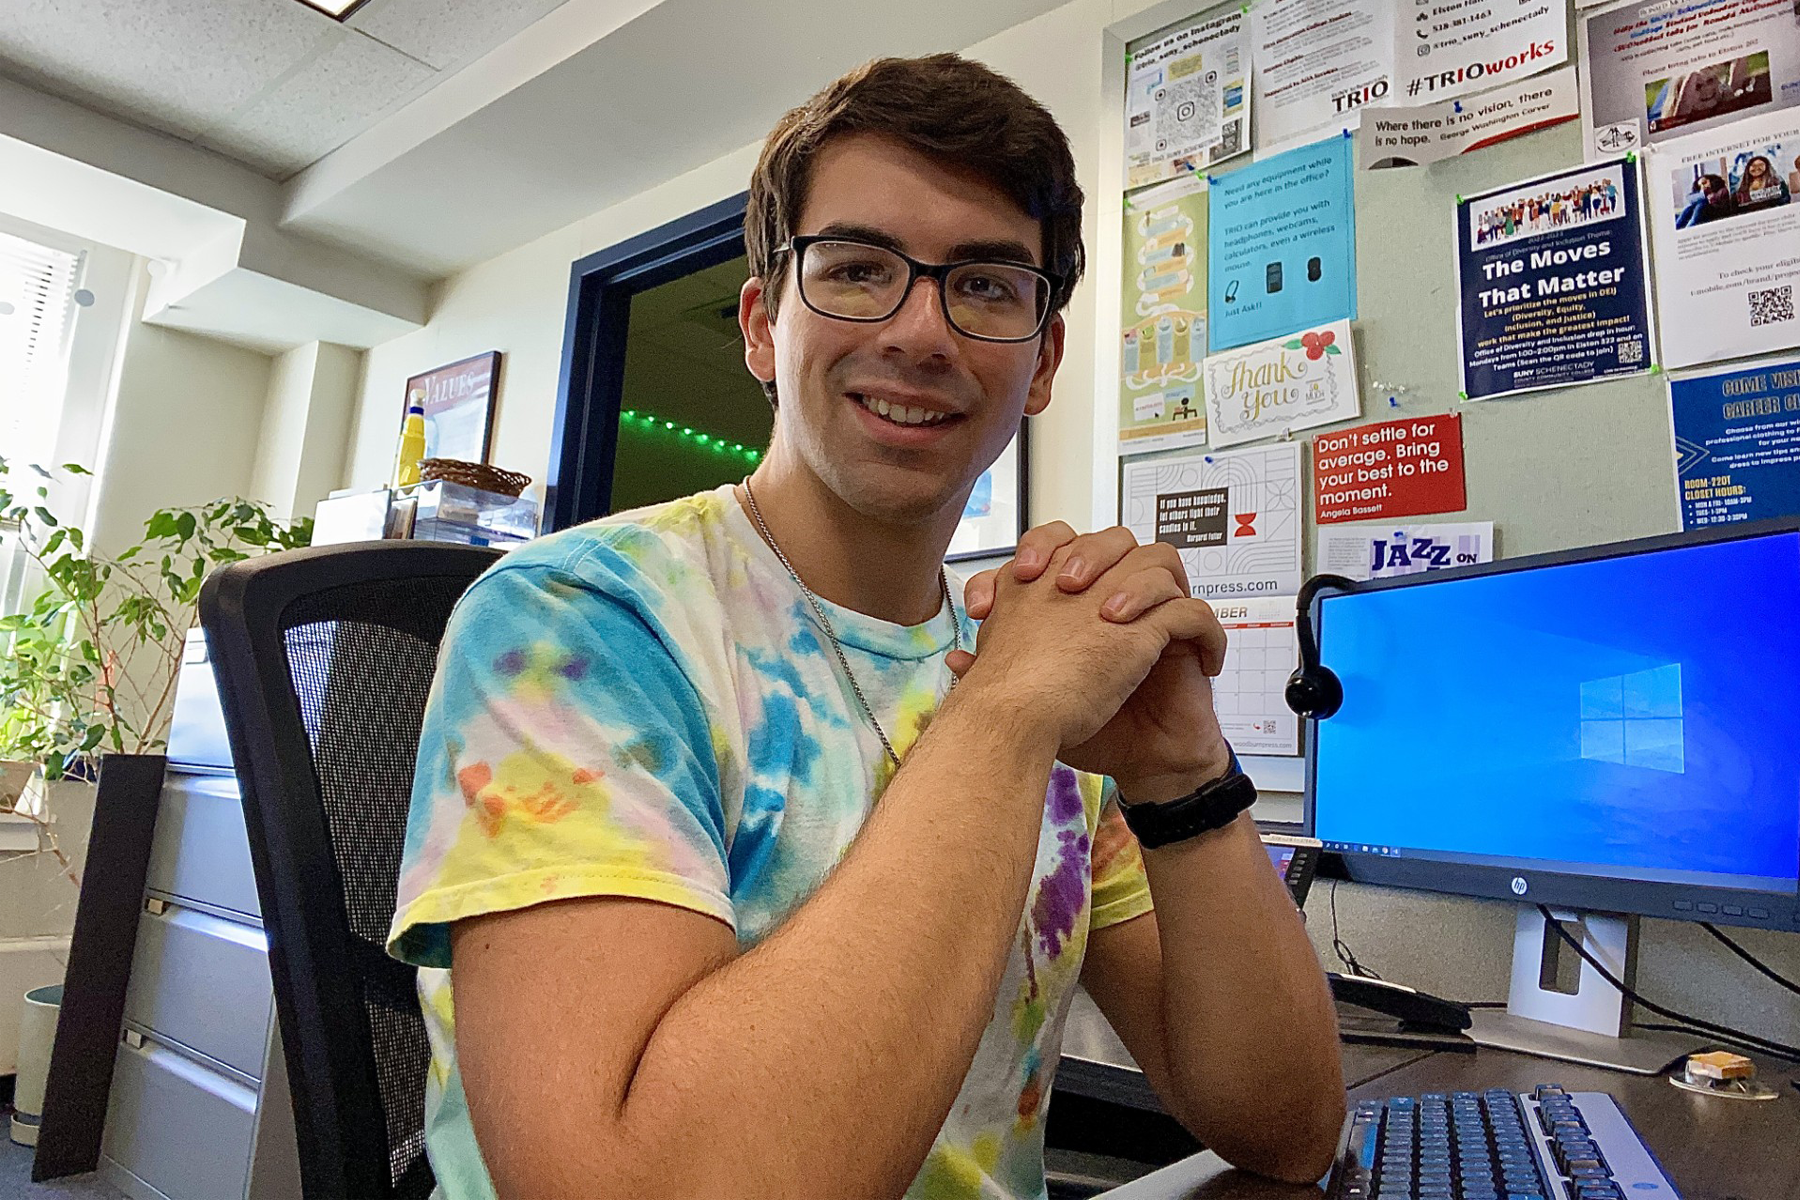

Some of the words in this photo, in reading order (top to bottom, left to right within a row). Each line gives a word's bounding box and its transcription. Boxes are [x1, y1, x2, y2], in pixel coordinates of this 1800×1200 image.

[1134, 44, 1161, 60] Follow
[1163, 38, 1174, 47] us
[1176, 32, 1188, 42] on
[1191, 13, 1242, 36] Instagram
[1406, 40, 1555, 97] #TRIOworks
[1331, 80, 1389, 112] TRIO
[1376, 120, 1409, 131] Where
[1411, 118, 1441, 130] there
[1446, 115, 1456, 126] is
[1459, 112, 1474, 123] no
[1478, 101, 1514, 117] vision,
[1519, 88, 1552, 104] there
[1440, 129, 1470, 142] George
[1472, 113, 1520, 131] Washington
[1522, 104, 1550, 117] Carver
[1376, 135, 1383, 146] is
[1385, 137, 1398, 146] no
[1401, 134, 1431, 147] hope.
[1681, 153, 1704, 163] FREE
[1705, 141, 1750, 157] INTERNET
[1224, 184, 1245, 196] Need
[1246, 179, 1261, 190] any
[1262, 165, 1306, 184] equipment
[1309, 157, 1332, 170] while
[1224, 199, 1239, 210] you
[1240, 194, 1252, 204] are
[1254, 188, 1273, 201] here
[1274, 184, 1283, 193] in
[1284, 180, 1299, 190] the
[1300, 170, 1330, 185] office?
[1224, 225, 1242, 236] TRIO
[1244, 222, 1259, 233] can
[1260, 210, 1291, 229] provide
[1293, 206, 1309, 217] you
[1310, 200, 1330, 211] with
[1224, 230, 1275, 248] headphones,
[1276, 217, 1319, 234] webcams,
[1224, 243, 1268, 261] calculators,
[1270, 237, 1291, 248] even
[1300, 224, 1336, 240] wireless
[1224, 261, 1250, 272] mouse
[1482, 259, 1524, 280] The
[1530, 241, 1611, 269] Moves
[1479, 283, 1531, 308] That
[1538, 267, 1625, 296] Matter
[1225, 307, 1240, 318] Just
[1484, 308, 1503, 318] Let's
[1504, 301, 1541, 315] prioritize
[1542, 298, 1557, 306] the
[1559, 294, 1587, 303] moves
[1588, 290, 1598, 298] in
[1512, 309, 1554, 321] (Diversity,
[1556, 304, 1586, 314] Equity,
[1478, 337, 1497, 348] work
[1499, 334, 1516, 343] that
[1517, 330, 1541, 339] make
[1542, 327, 1557, 335] the
[1559, 321, 1595, 335] greatest
[1597, 315, 1630, 326] impact!
[1504, 320, 1544, 333] Inclusion,
[1545, 316, 1562, 325] and
[1469, 356, 1499, 368] Mondays
[1500, 353, 1517, 361] from
[1518, 344, 1567, 357] 1:00-2:00pm
[1567, 342, 1575, 350] in
[1575, 339, 1600, 349] Elston
[1616, 335, 1632, 343] and
[1474, 348, 1495, 358] Office
[1495, 345, 1503, 353] of
[1503, 341, 1536, 351] Diversity
[1537, 337, 1551, 346] and
[1552, 332, 1586, 343] Inclusion
[1587, 330, 1605, 339] drop
[1493, 363, 1516, 371] Teams
[1517, 358, 1539, 367] (Scan
[1539, 355, 1552, 363] the
[1565, 351, 1586, 359] code
[1596, 345, 1614, 357] join)
[1513, 369, 1535, 378] SUNY
[1536, 361, 1594, 375] SCHENECTADY
[1221, 351, 1308, 400] Thank
[1722, 374, 1768, 397] COME
[1306, 389, 1325, 401] MUCH
[1723, 396, 1781, 420] CAREER
[1318, 434, 1358, 453] Don't
[1362, 426, 1407, 446] settle
[1411, 423, 1436, 437] for
[1706, 434, 1751, 446] professional
[1752, 430, 1785, 438] clothing
[1725, 426, 1754, 435] Choose
[1771, 437, 1789, 446] your
[1318, 448, 1391, 471] average.
[1396, 441, 1440, 458] Bring
[1711, 455, 1734, 463] Come
[1734, 452, 1754, 460] learn
[1773, 448, 1788, 456] tips
[1729, 460, 1751, 469] dress
[1760, 456, 1792, 465] impress
[1319, 471, 1354, 491] your
[1358, 466, 1394, 483] best
[1397, 462, 1415, 477] to
[1419, 458, 1449, 474] the
[1160, 499, 1166, 509] If
[1166, 499, 1177, 510] you
[1178, 497, 1192, 507] have
[1319, 483, 1392, 506] moment.
[1685, 488, 1713, 501] CLOSET
[1714, 485, 1747, 498] HOURS:
[1169, 510, 1189, 521] others
[1189, 507, 1204, 519] light
[1204, 506, 1220, 517] their
[1320, 506, 1351, 519] Angela
[1352, 504, 1382, 515] Bassett
[1159, 523, 1181, 534] candles
[1372, 538, 1451, 572] JAZZ
[1456, 553, 1478, 564] ON
[1191, 579, 1278, 596] rnpress.com
[1233, 741, 1292, 750] woodburnpress.com
[1513, 877, 1527, 894] hp
